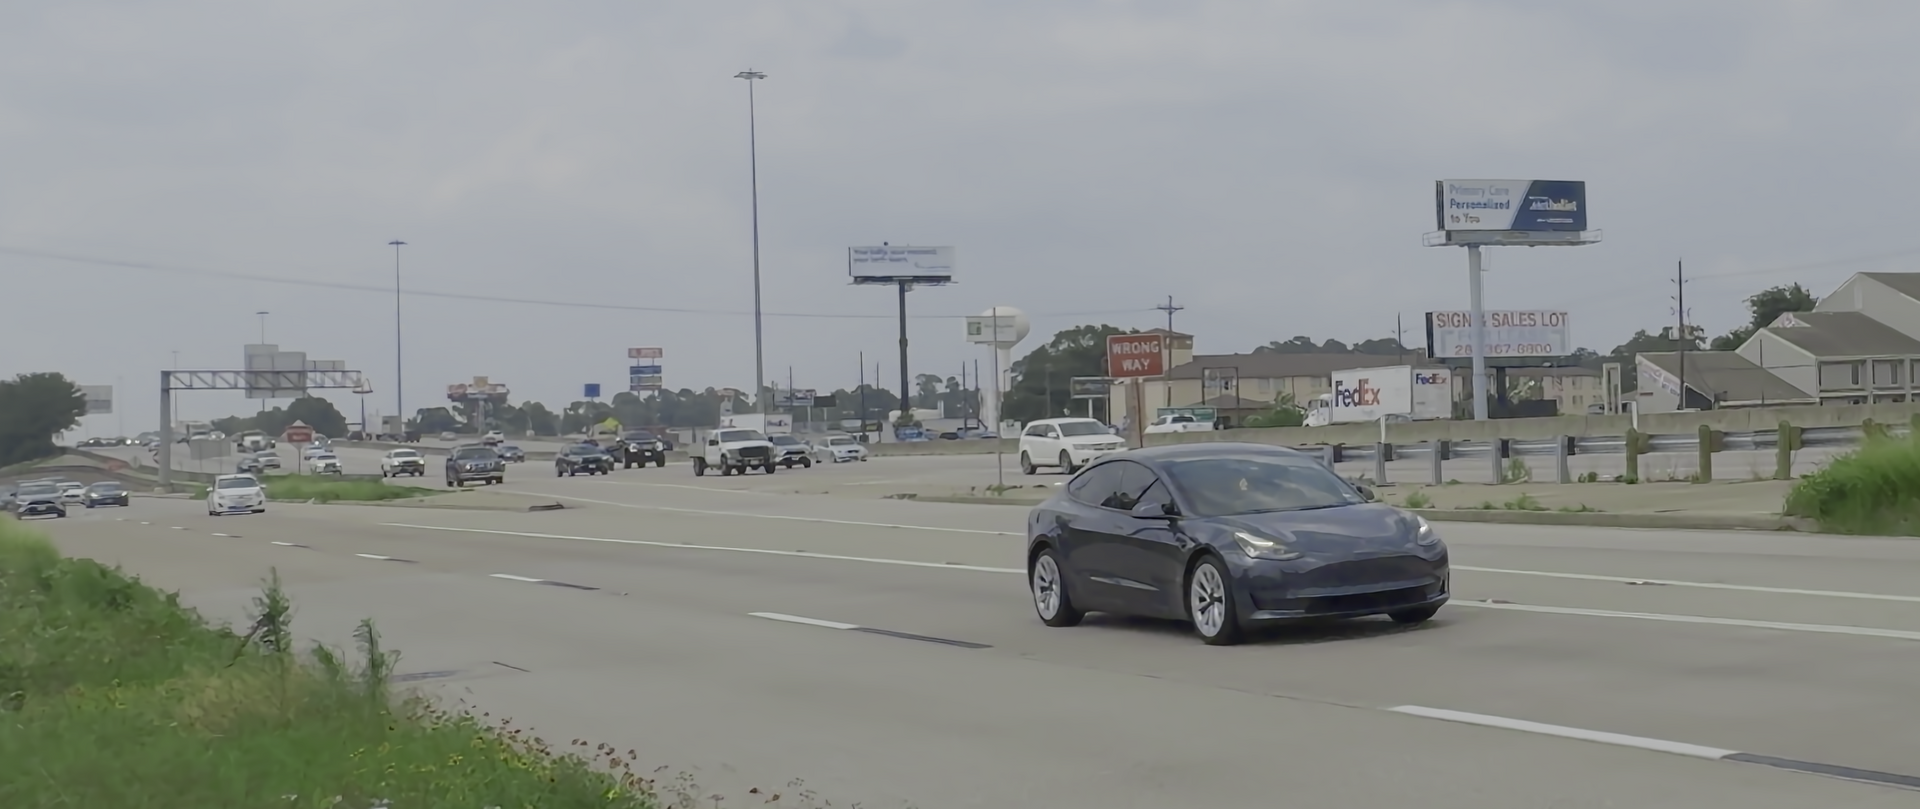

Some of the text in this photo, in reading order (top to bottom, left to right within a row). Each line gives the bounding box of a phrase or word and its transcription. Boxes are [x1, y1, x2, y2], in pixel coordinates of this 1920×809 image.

[1489, 185, 1510, 196] Care
[1491, 312, 1537, 327] SALES
[1541, 312, 1568, 327] LOT
[1111, 341, 1159, 354] WRONG
[1122, 358, 1150, 371] WAY
[1415, 373, 1447, 385] FedEx
[1335, 378, 1381, 408] FedEx
